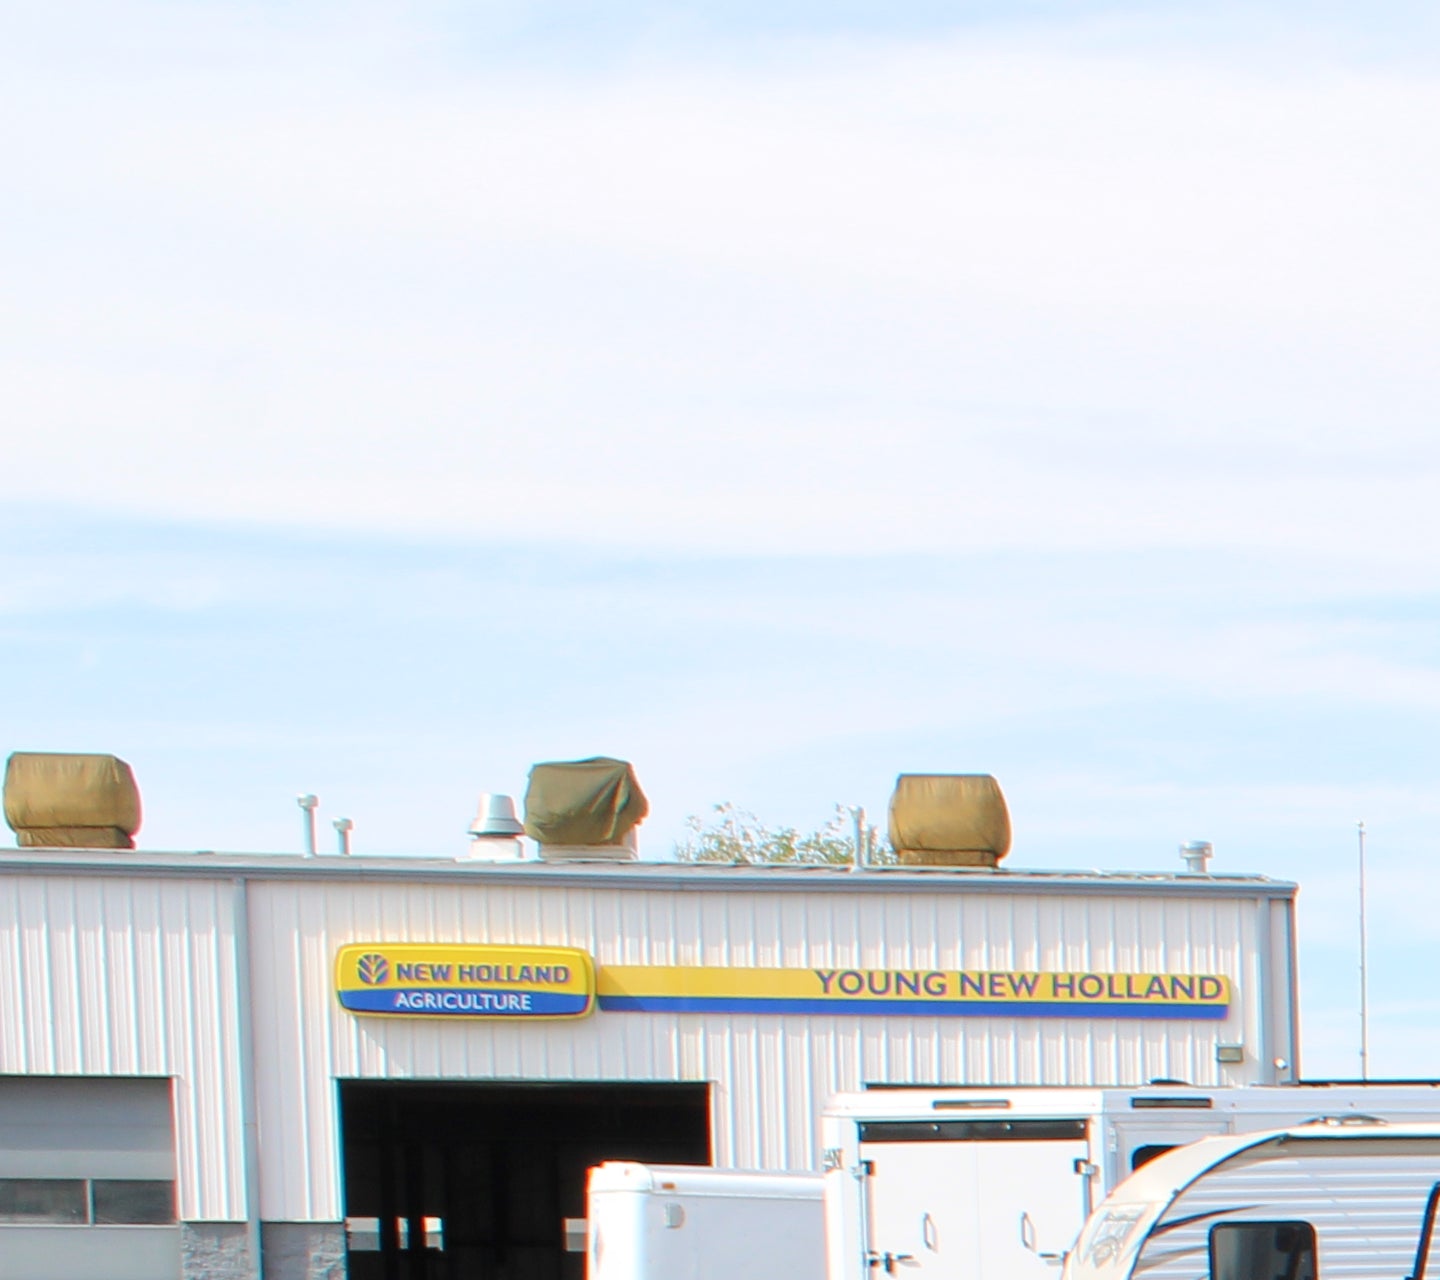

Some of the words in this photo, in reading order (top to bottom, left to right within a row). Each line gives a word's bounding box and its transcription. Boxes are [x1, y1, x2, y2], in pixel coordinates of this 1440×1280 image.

[396, 962, 450, 982] NEW
[458, 964, 570, 984] HOLLAND
[815, 970, 947, 996] YOUNG
[960, 973, 1040, 998] NEW
[1052, 975, 1223, 1001] HOLLAND
[395, 992, 532, 1011] AGRICULTURE
